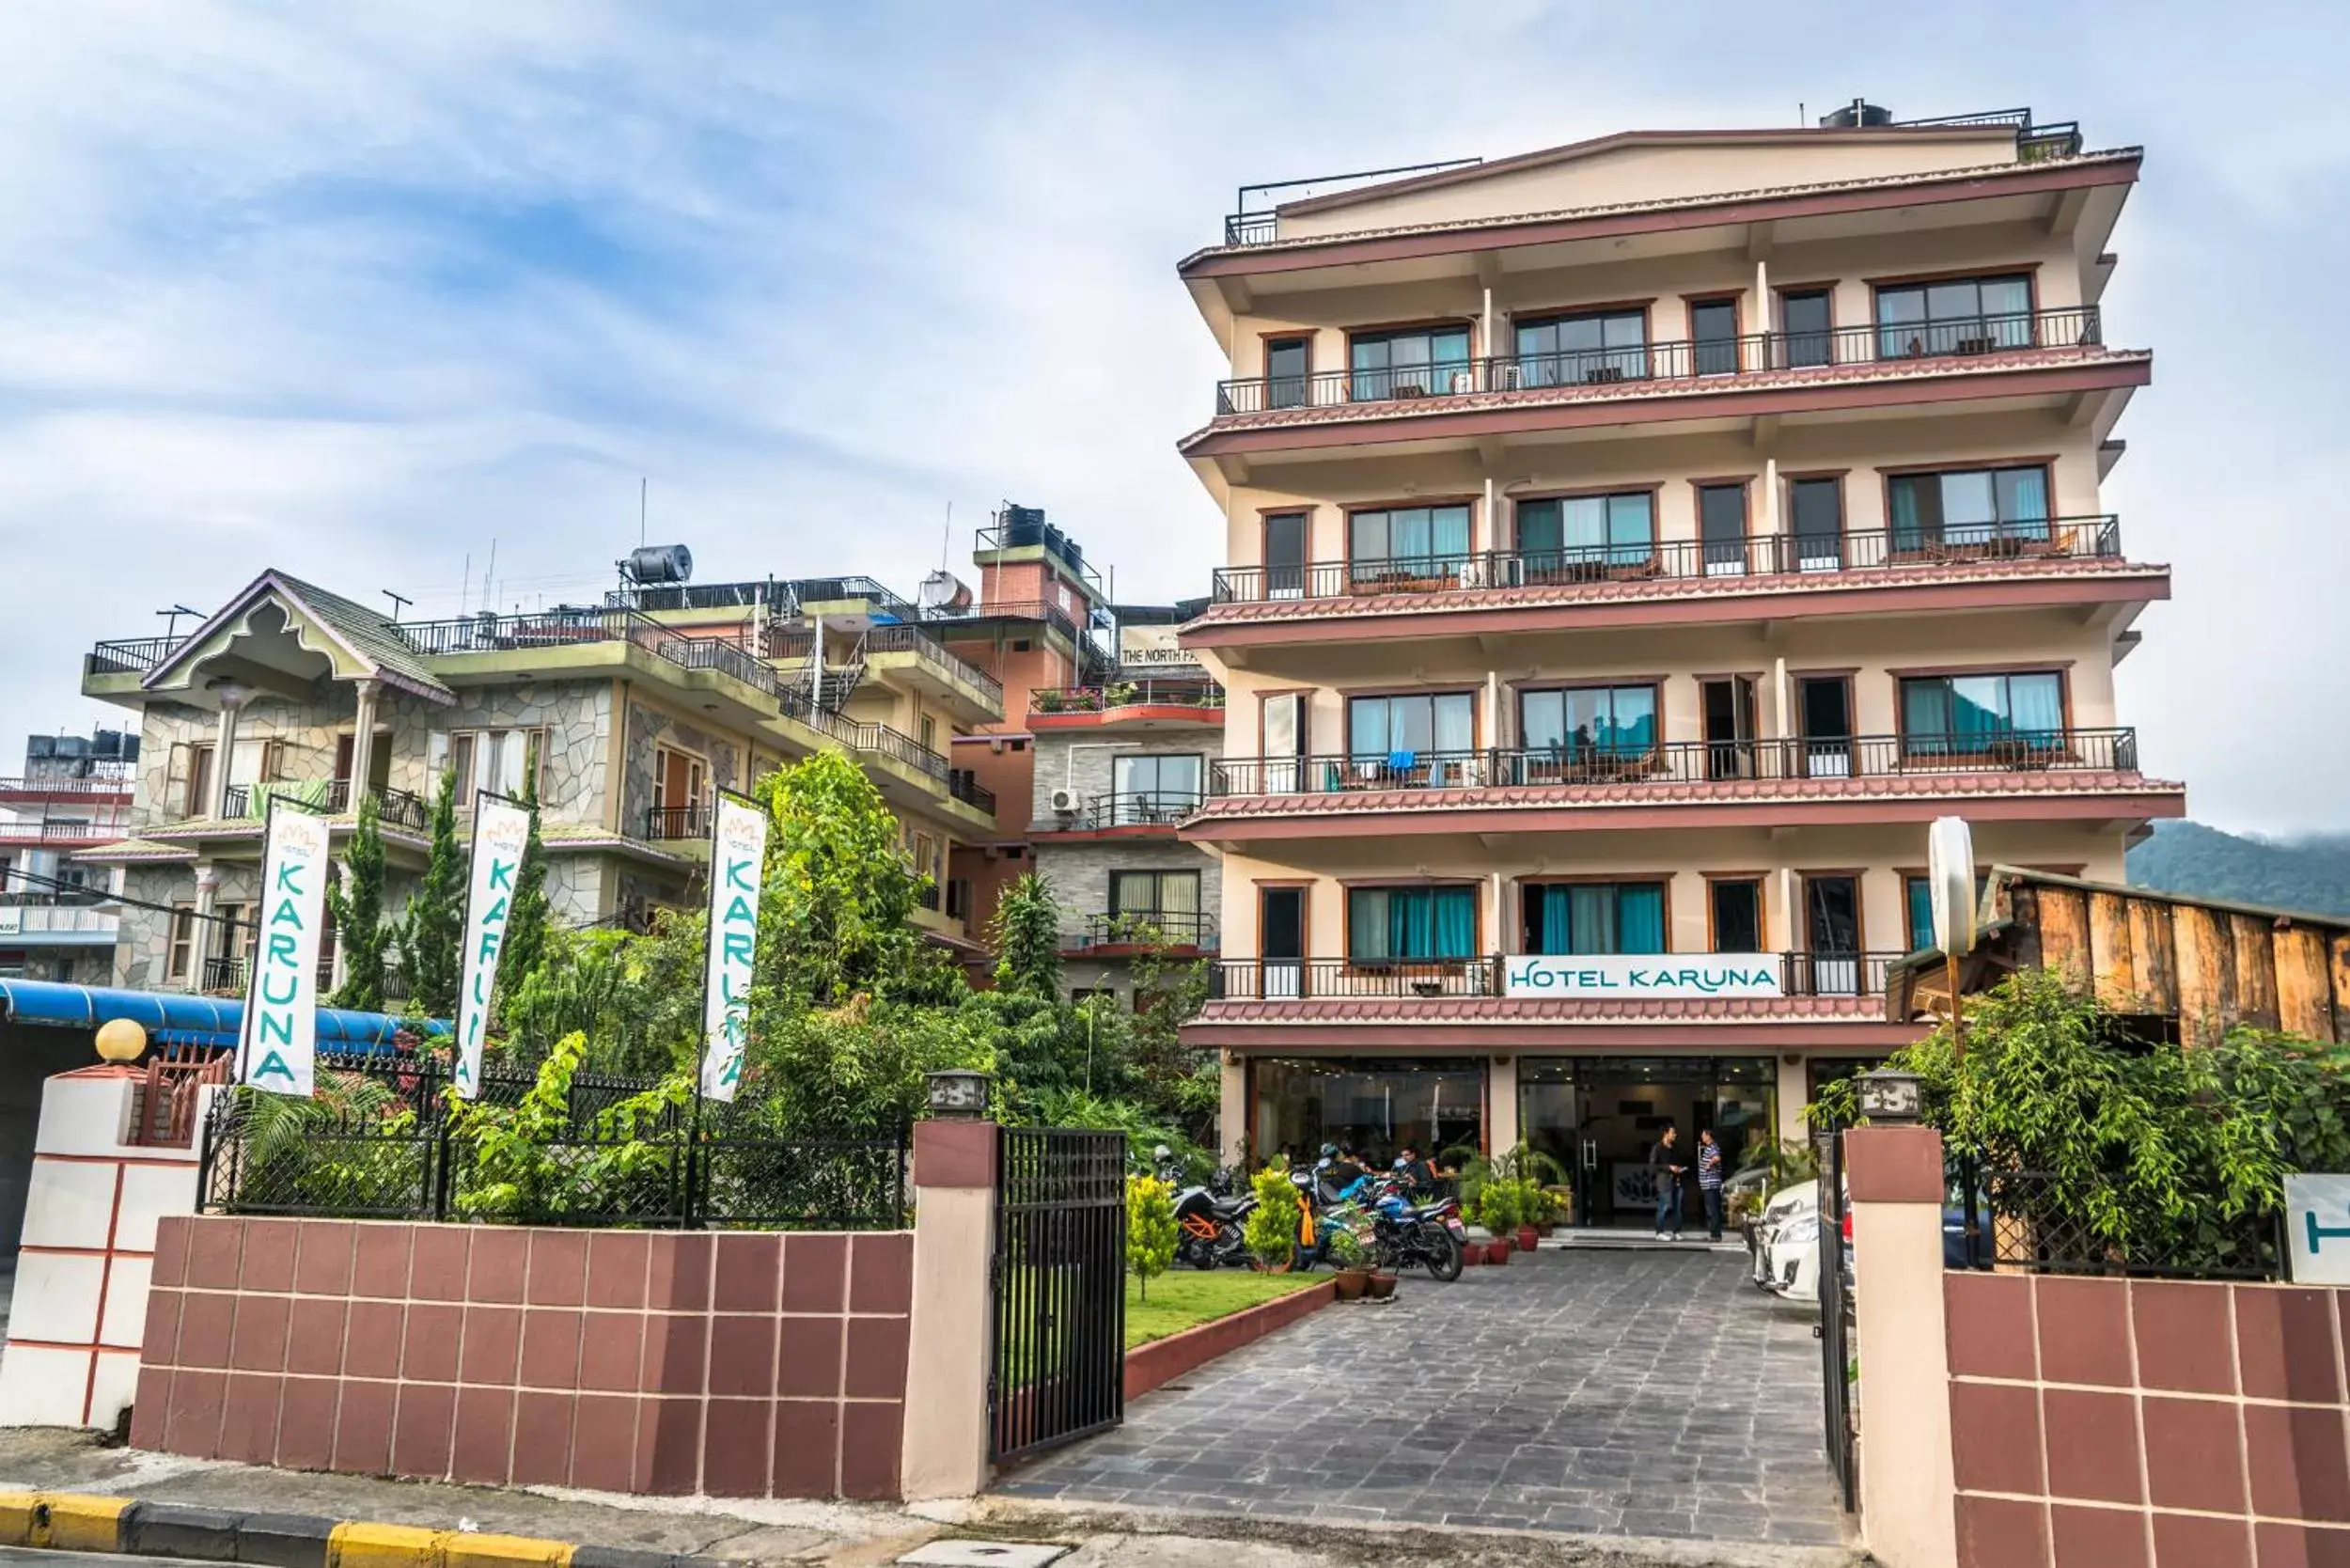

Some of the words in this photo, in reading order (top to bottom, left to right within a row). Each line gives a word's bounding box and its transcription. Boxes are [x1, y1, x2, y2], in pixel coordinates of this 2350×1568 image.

[1123, 649, 1143, 663] THE
[1146, 648, 1181, 662] NORTH
[252, 860, 306, 1082] KARUNA
[1511, 960, 1619, 988] HOTEL
[1628, 968, 1776, 993] KARUNA
